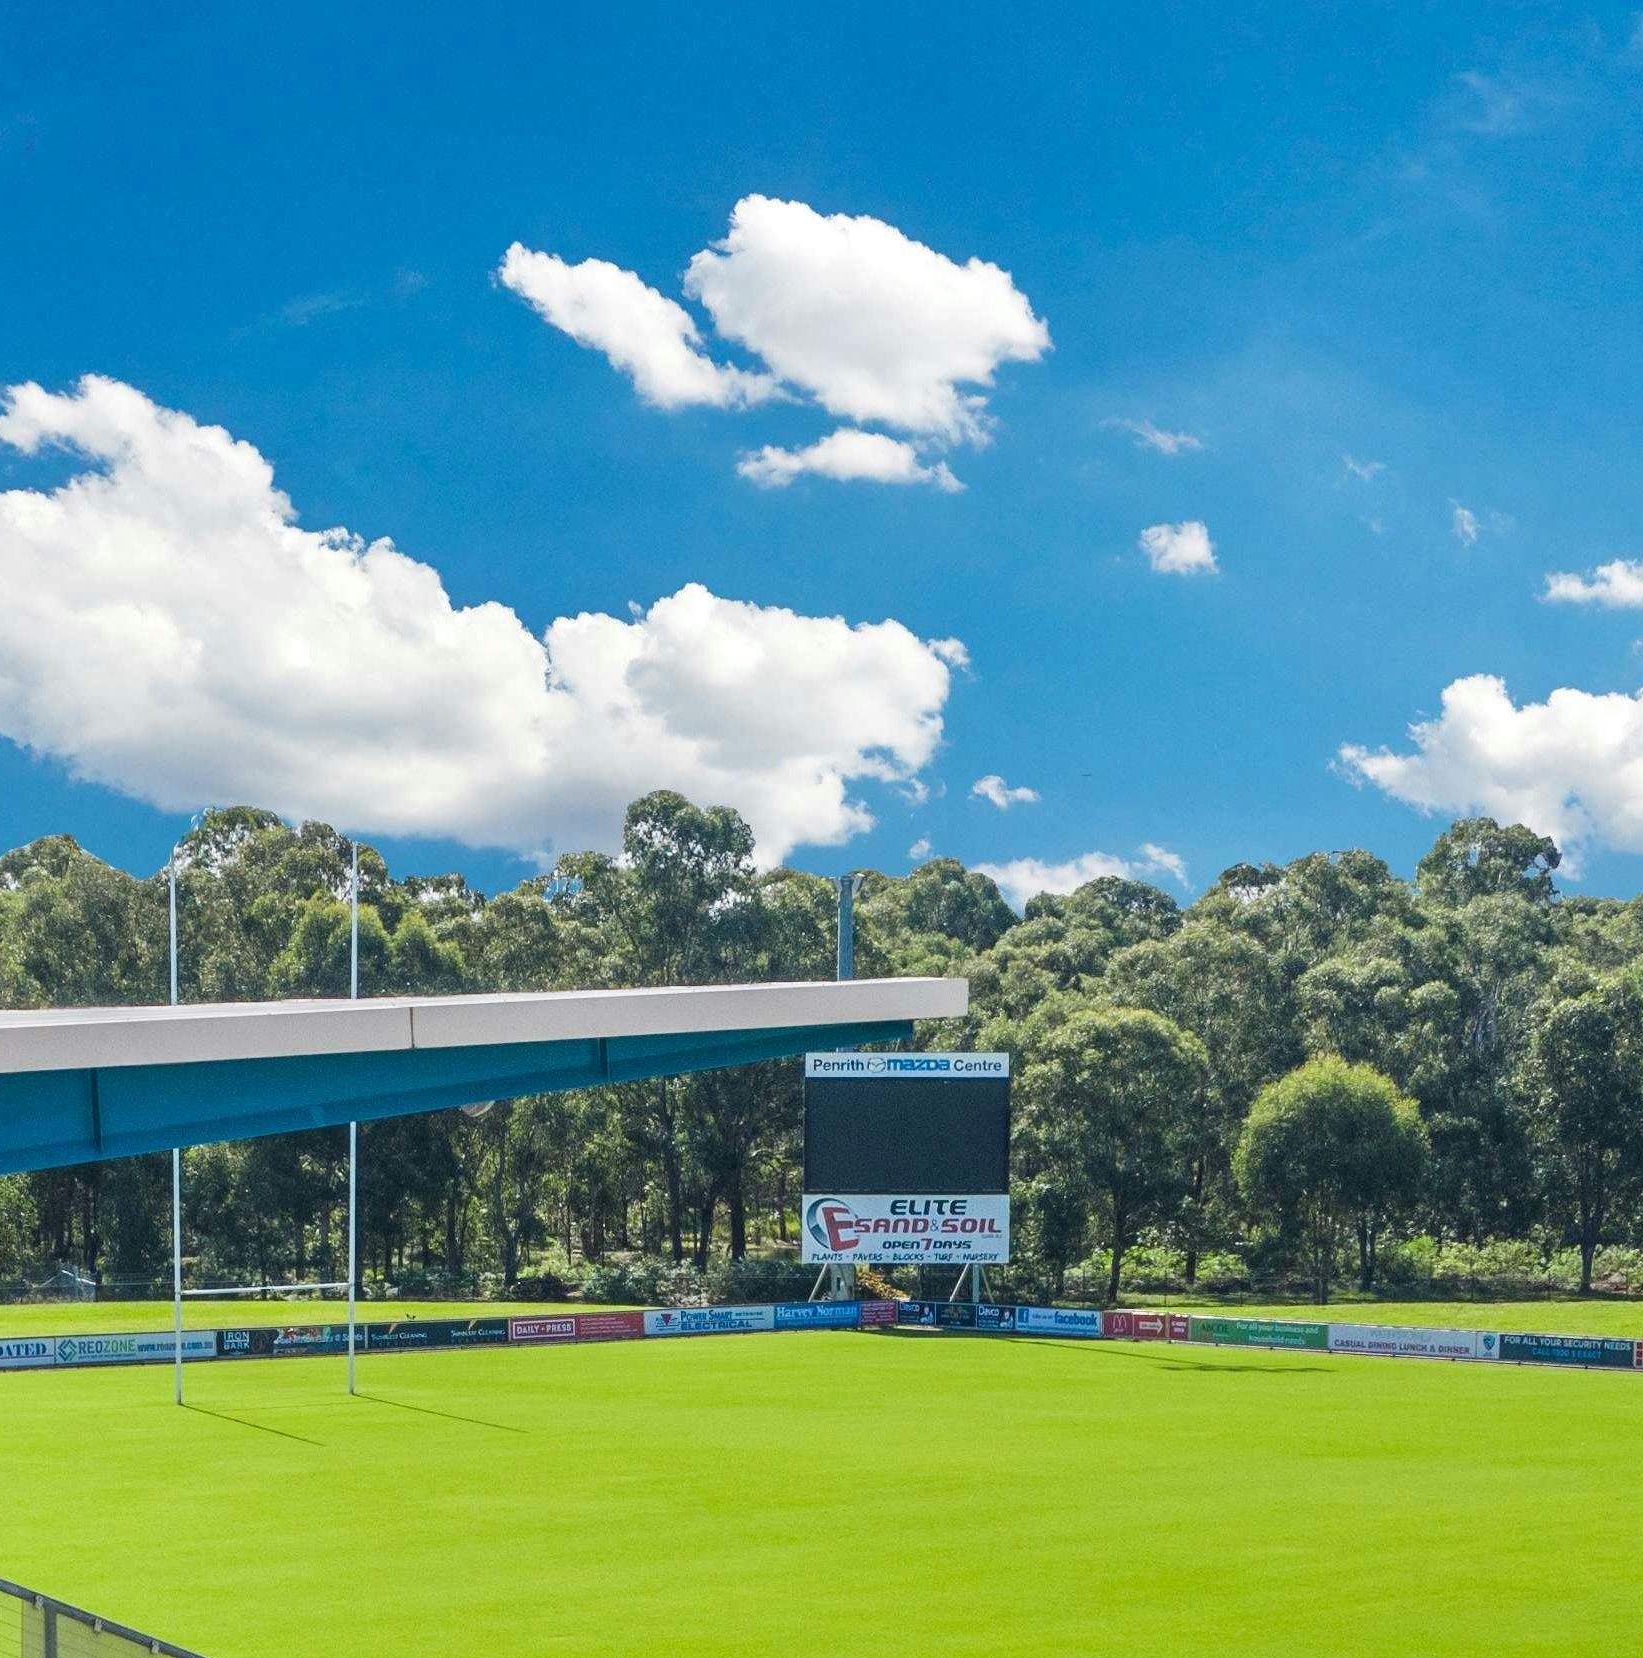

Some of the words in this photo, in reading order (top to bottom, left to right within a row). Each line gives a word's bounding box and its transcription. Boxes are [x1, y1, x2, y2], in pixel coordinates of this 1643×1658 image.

[813, 1059, 864, 1072] Penrith
[886, 1058, 951, 1072] mazda
[953, 1059, 1002, 1072] Centre
[890, 1199, 968, 1216] ELITE
[882, 1240, 922, 1250] OPEN
[920, 1238, 933, 1251] 7
[932, 1240, 972, 1250] DAYS
[811, 1252, 843, 1262] PLANTS
[852, 1252, 883, 1262] PAVERS
[892, 1252, 924, 1262] BLOCKS
[934, 1252, 954, 1262] TURF
[962, 1252, 1000, 1262] NURSERY
[776, 1306, 814, 1319] Harvey
[815, 1305, 857, 1317] Norman
[1054, 1310, 1097, 1326] facebook
[516, 1323, 540, 1335] DAILY
[680, 1320, 752, 1331] ELECTRICAL
[224, 1331, 250, 1341] IRON
[78, 1338, 136, 1355] REOZONE
[1334, 1338, 1366, 1348] CASUAL
[1504, 1336, 1519, 1345] FOR
[1521, 1336, 1538, 1346] ALL
[1539, 1337, 1562, 1347] YOUR
[1563, 1338, 1603, 1349] SECURITY
[1605, 1340, 1632, 1351] NEEDS
